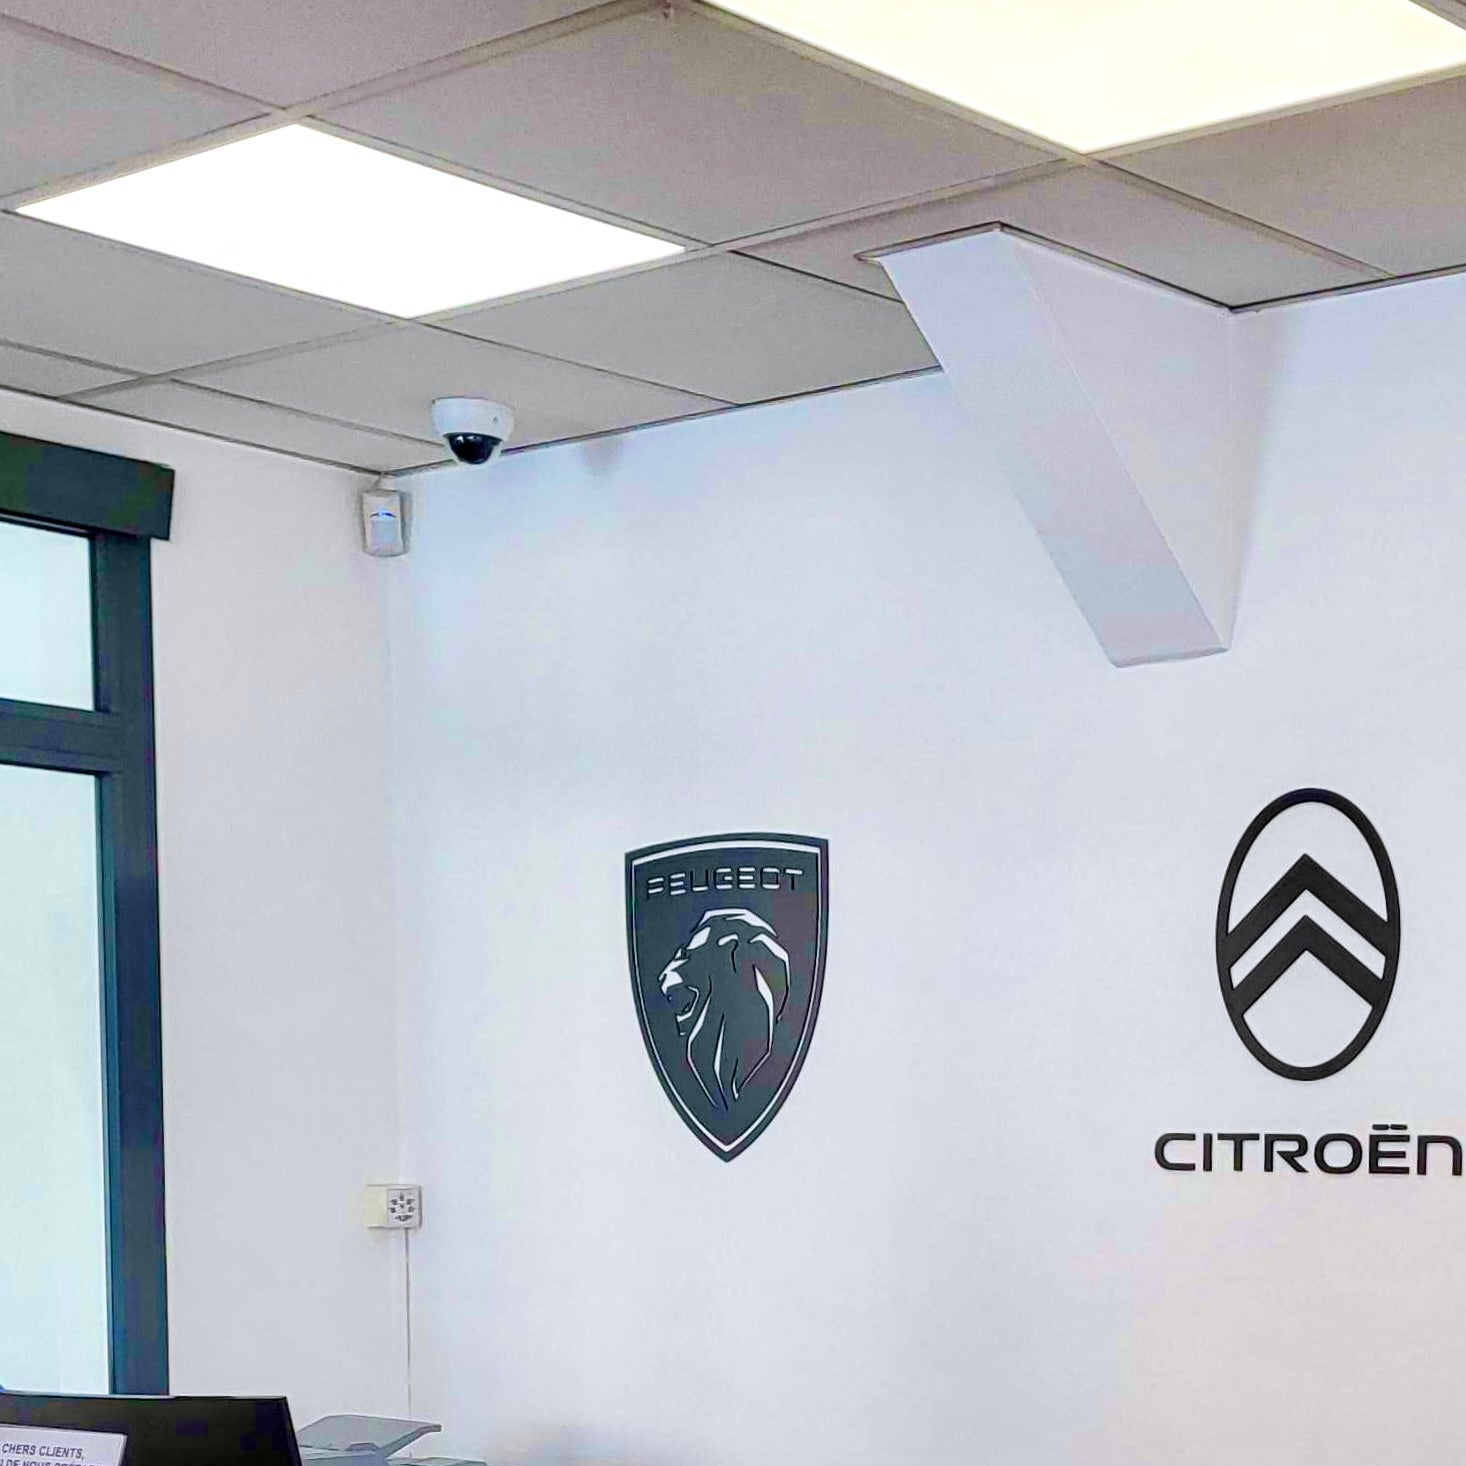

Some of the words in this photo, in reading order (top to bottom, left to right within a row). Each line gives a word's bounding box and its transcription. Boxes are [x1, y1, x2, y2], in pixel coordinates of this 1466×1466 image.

[647, 867, 803, 900] PEUGEOT
[2, 1443, 37, 1455] CHERS
[39, 1446, 84, 1460] CLIENTS,
